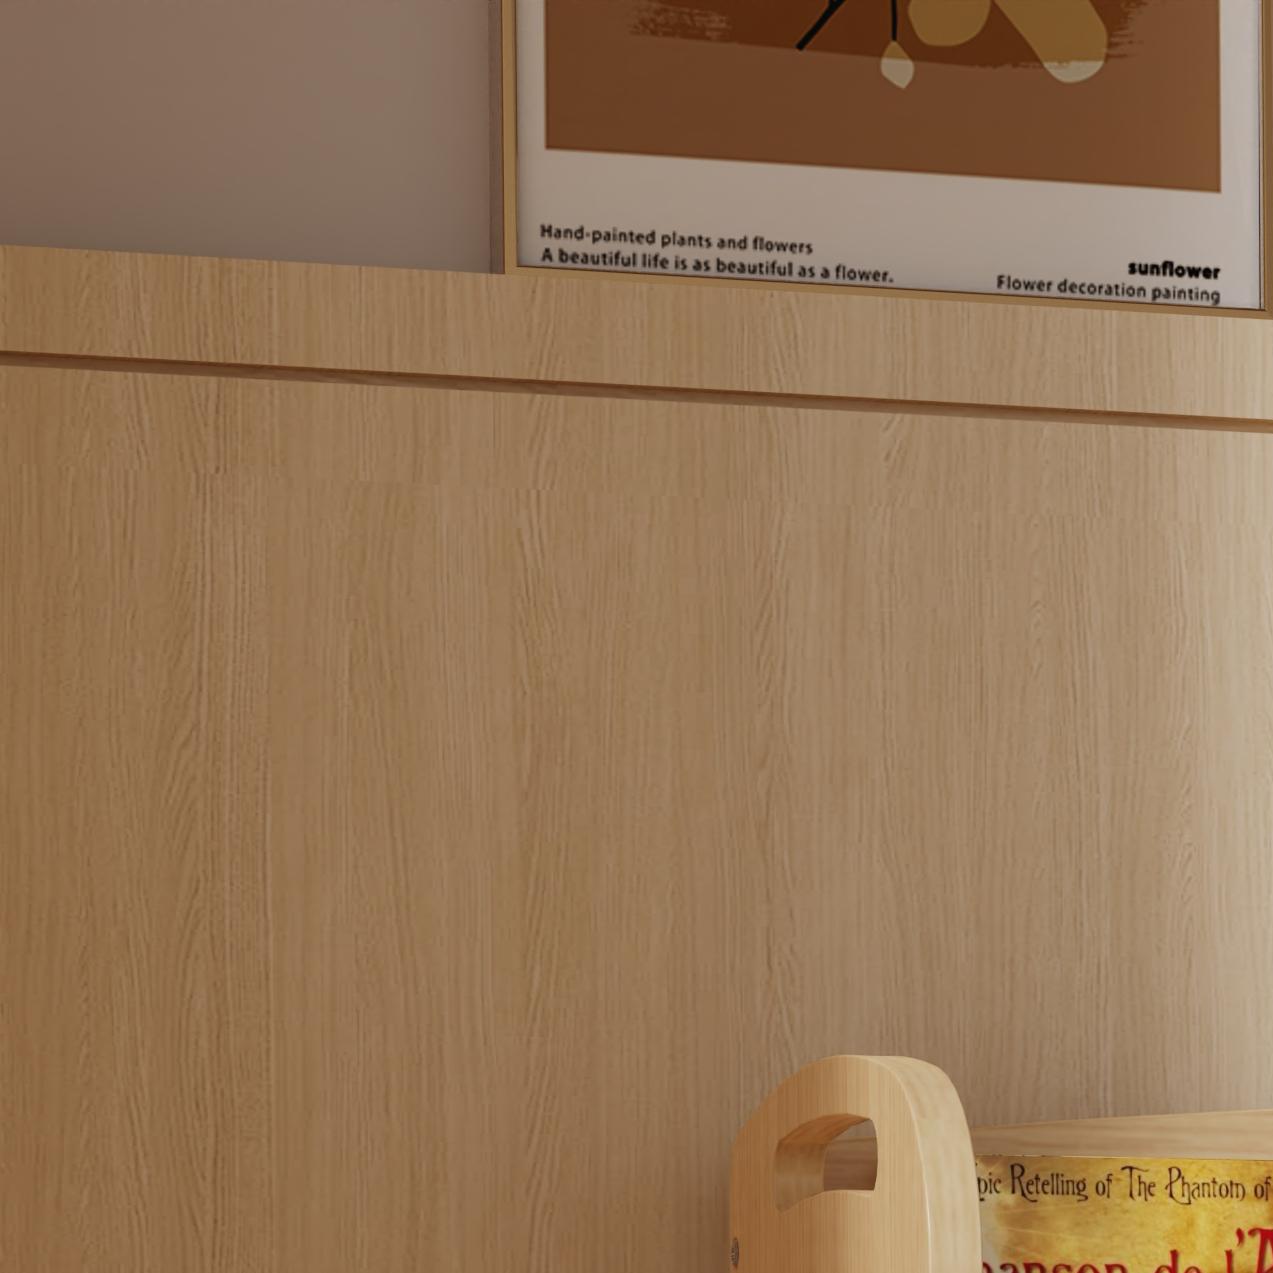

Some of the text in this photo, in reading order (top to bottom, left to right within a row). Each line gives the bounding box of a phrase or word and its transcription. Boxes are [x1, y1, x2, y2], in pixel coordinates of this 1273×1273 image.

[540, 224, 814, 255] Hand-painted plants and flowers
[541, 248, 895, 283] A beautiful life is as beautiful as a flower.
[1127, 260, 1221, 280] sunflower
[996, 274, 1221, 305] Flower decoration painting
[977, 1171, 1002, 1202] pic
[1009, 1163, 1089, 1203] Retelling
[1095, 1171, 1113, 1198] of
[1121, 1165, 1156, 1200] The
[1165, 1165, 1247, 1206] Phantom
[1253, 1174, 1272, 1202] of
